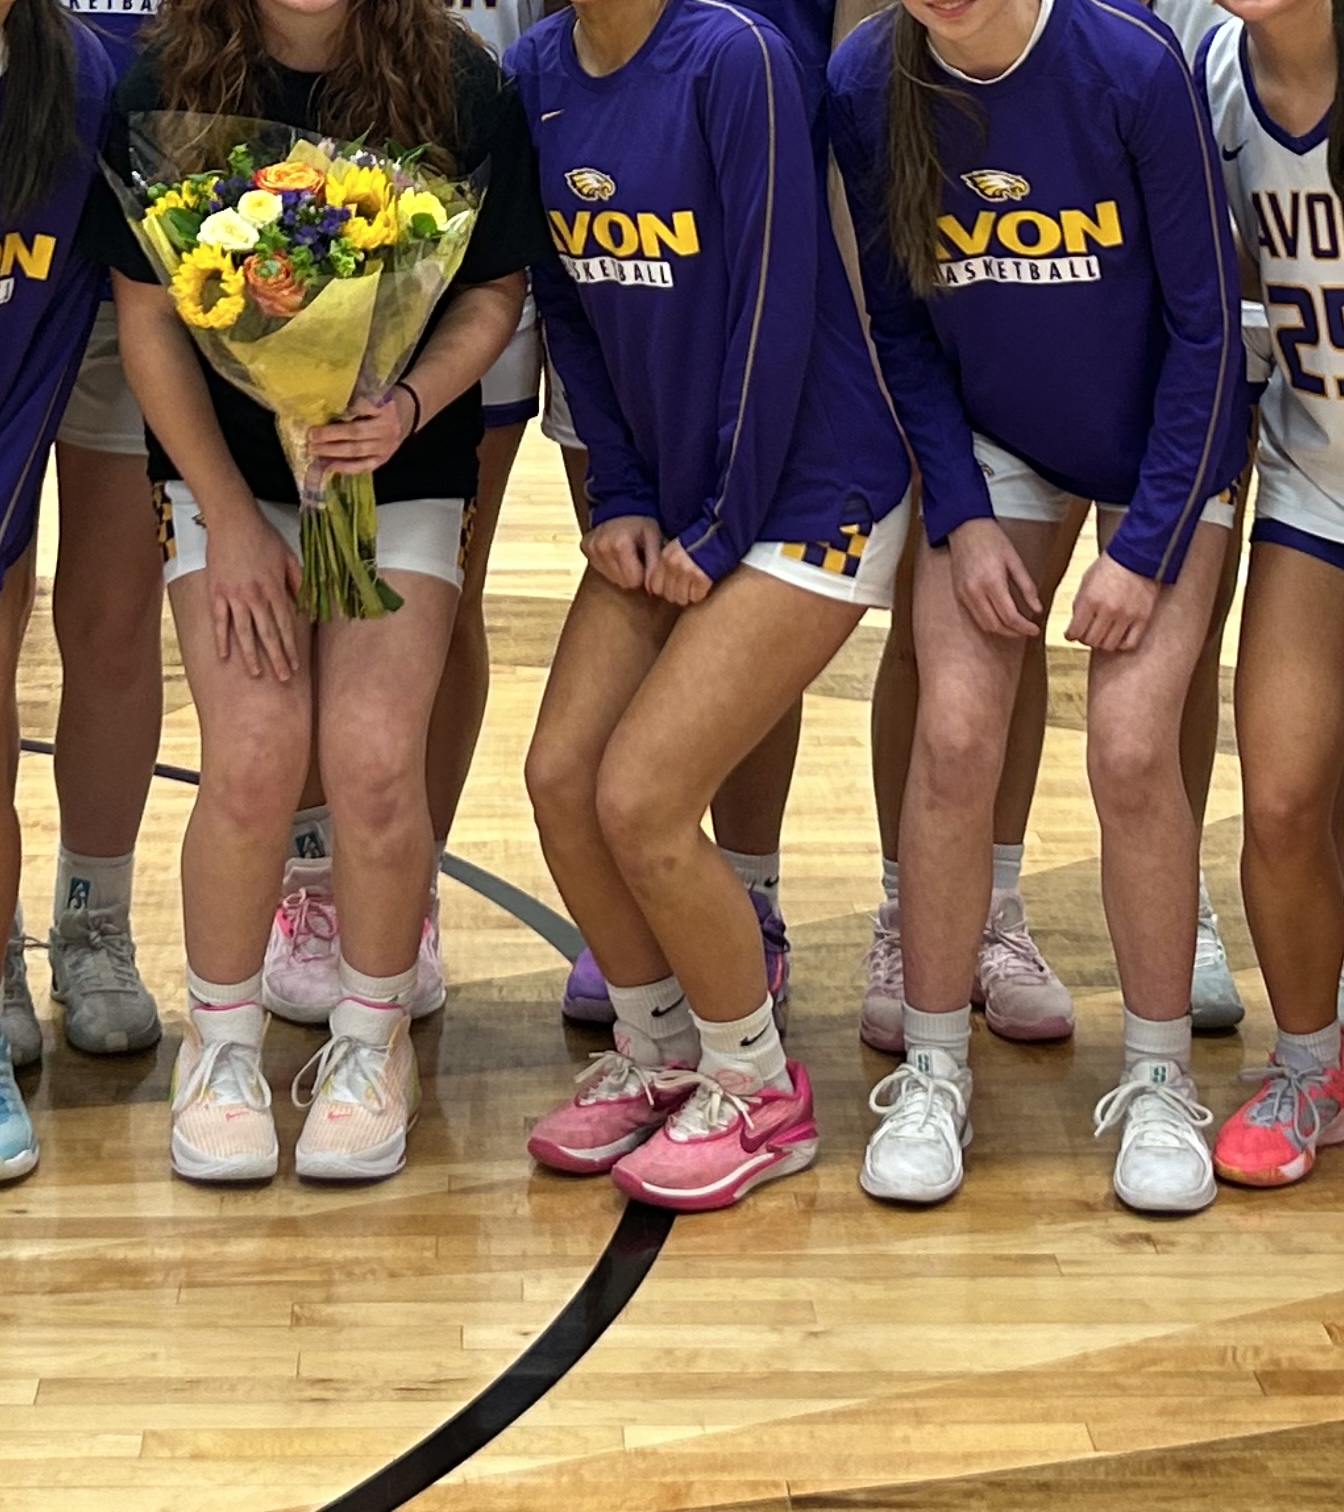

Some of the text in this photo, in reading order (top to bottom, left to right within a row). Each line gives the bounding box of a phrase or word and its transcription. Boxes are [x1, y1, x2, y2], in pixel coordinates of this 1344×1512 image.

[548, 210, 700, 257] VON
[936, 200, 1123, 259] VON
[936, 257, 1097, 285] ASKETBALL
